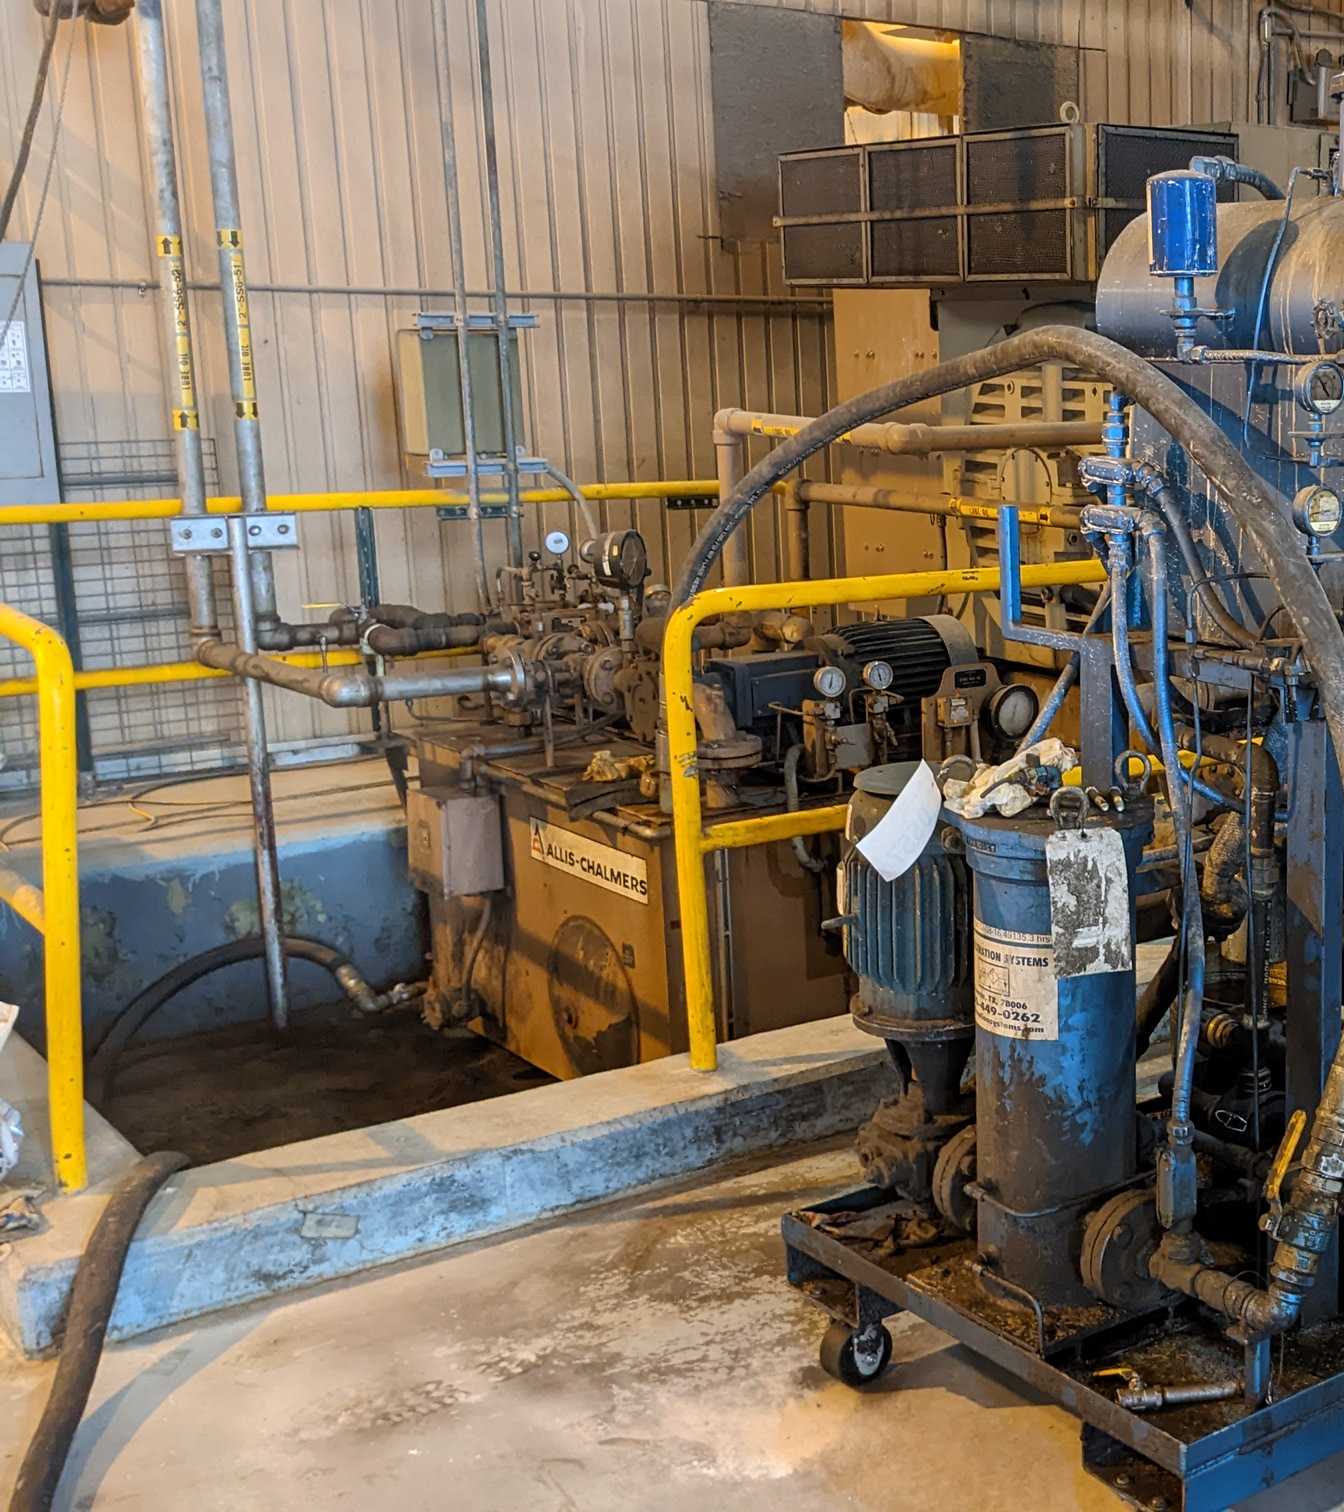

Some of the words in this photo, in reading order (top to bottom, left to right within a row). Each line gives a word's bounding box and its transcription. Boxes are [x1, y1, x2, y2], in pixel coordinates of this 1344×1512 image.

[243, 362, 252, 381] LUBE
[547, 843, 647, 896] ALLIS-CHALMERS
[1003, 953, 1049, 967] SYSTEMS
